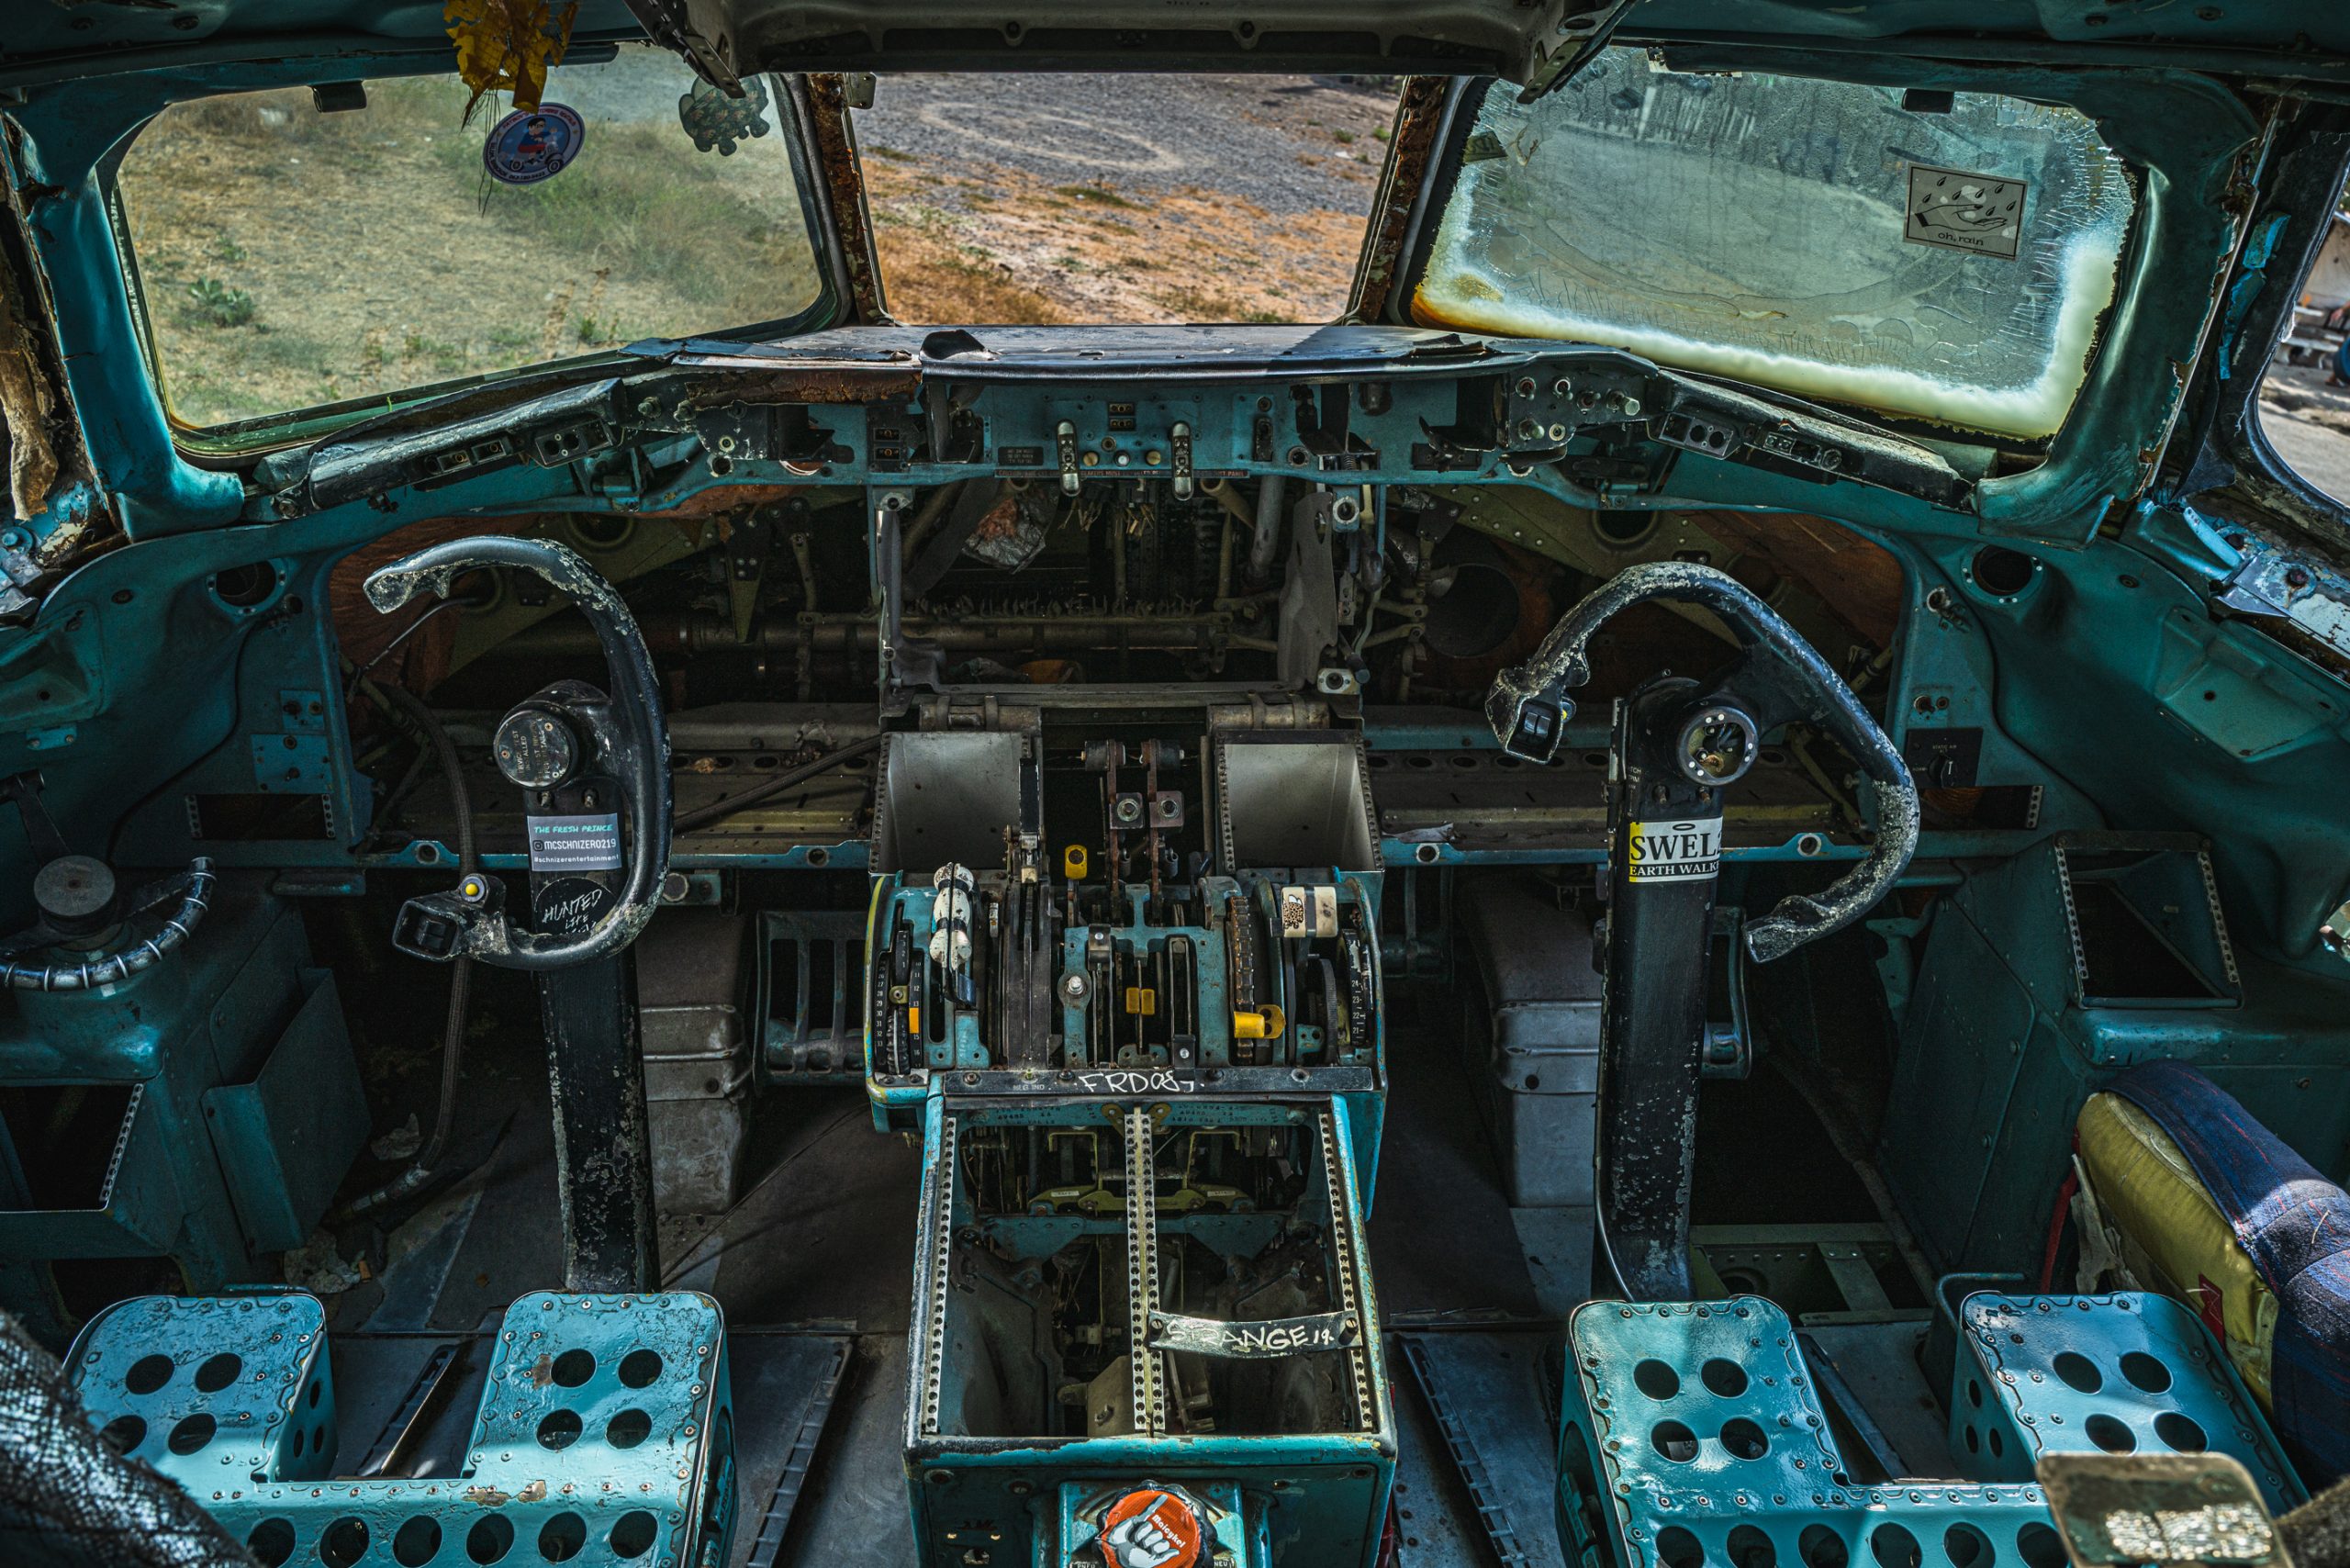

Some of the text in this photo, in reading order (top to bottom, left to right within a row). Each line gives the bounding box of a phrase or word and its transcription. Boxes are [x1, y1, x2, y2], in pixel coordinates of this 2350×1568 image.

[1938, 231, 1984, 246] oh, rain
[553, 825, 578, 834] FRESH
[581, 824, 613, 833] PRINCE
[1629, 865, 1675, 876] EARTH
[542, 889, 602, 924] HUNTED
[1167, 1319, 1309, 1350] STRANGE
